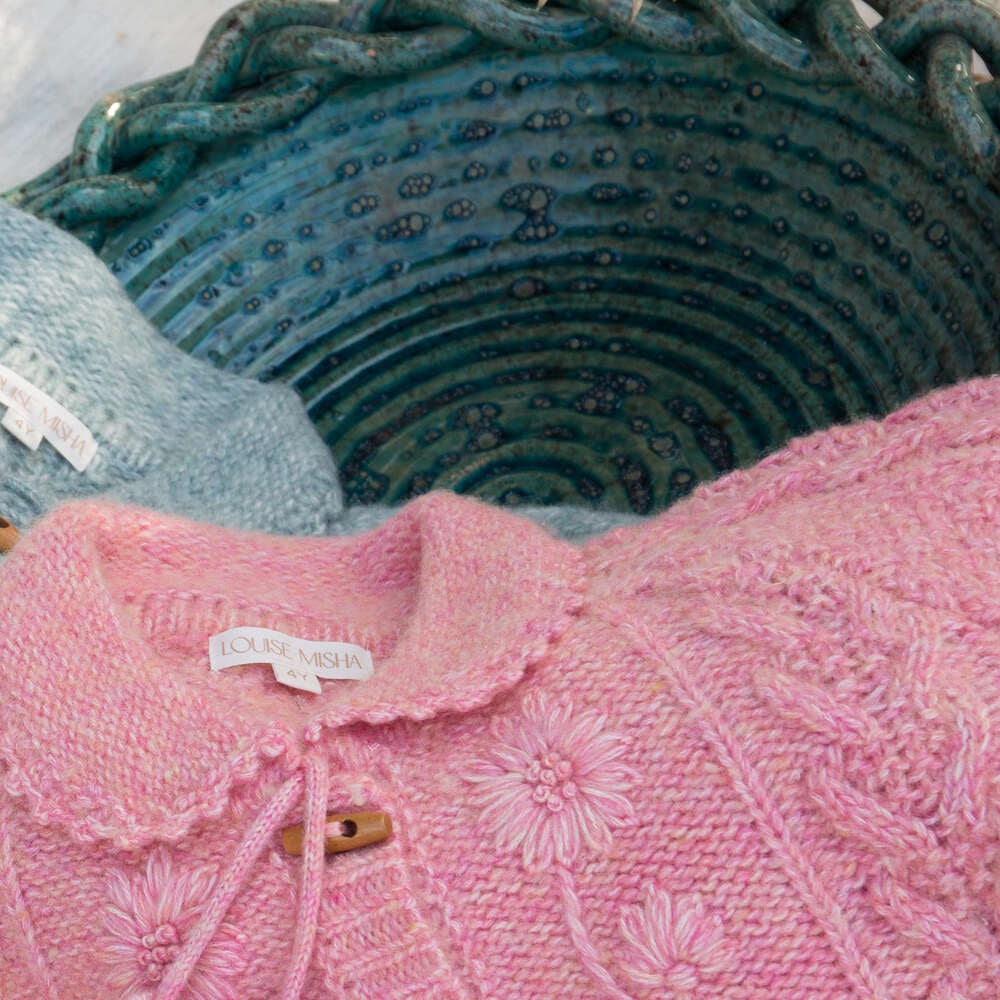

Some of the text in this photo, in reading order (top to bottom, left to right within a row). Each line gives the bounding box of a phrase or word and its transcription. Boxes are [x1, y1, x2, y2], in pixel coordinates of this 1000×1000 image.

[41, 407, 86, 457] MISHA
[221, 636, 363, 670] LOUISE MISHA
